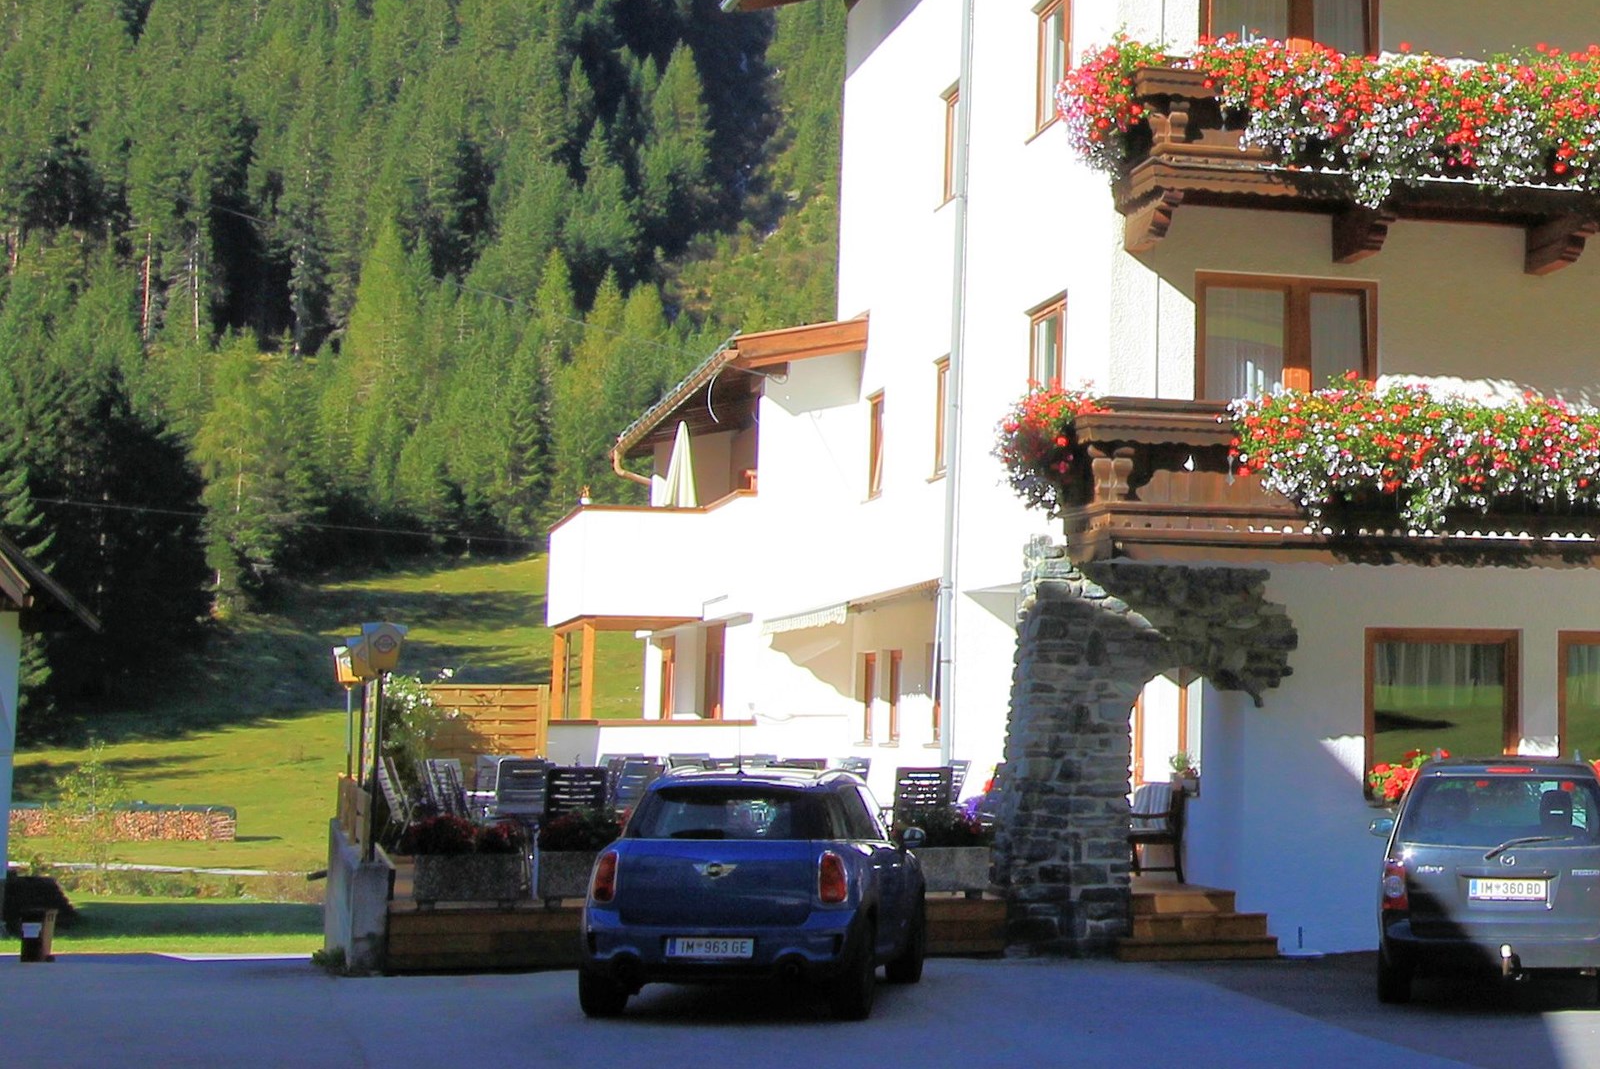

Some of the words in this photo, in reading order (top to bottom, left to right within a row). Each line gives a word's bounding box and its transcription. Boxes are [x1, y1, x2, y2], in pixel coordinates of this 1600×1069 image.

[1481, 882, 1493, 893] IM
[1502, 882, 1524, 894] 360
[1526, 883, 1541, 895] BD
[681, 940, 695, 953] IM
[704, 941, 728, 953] 963
[731, 941, 748, 953] GE
